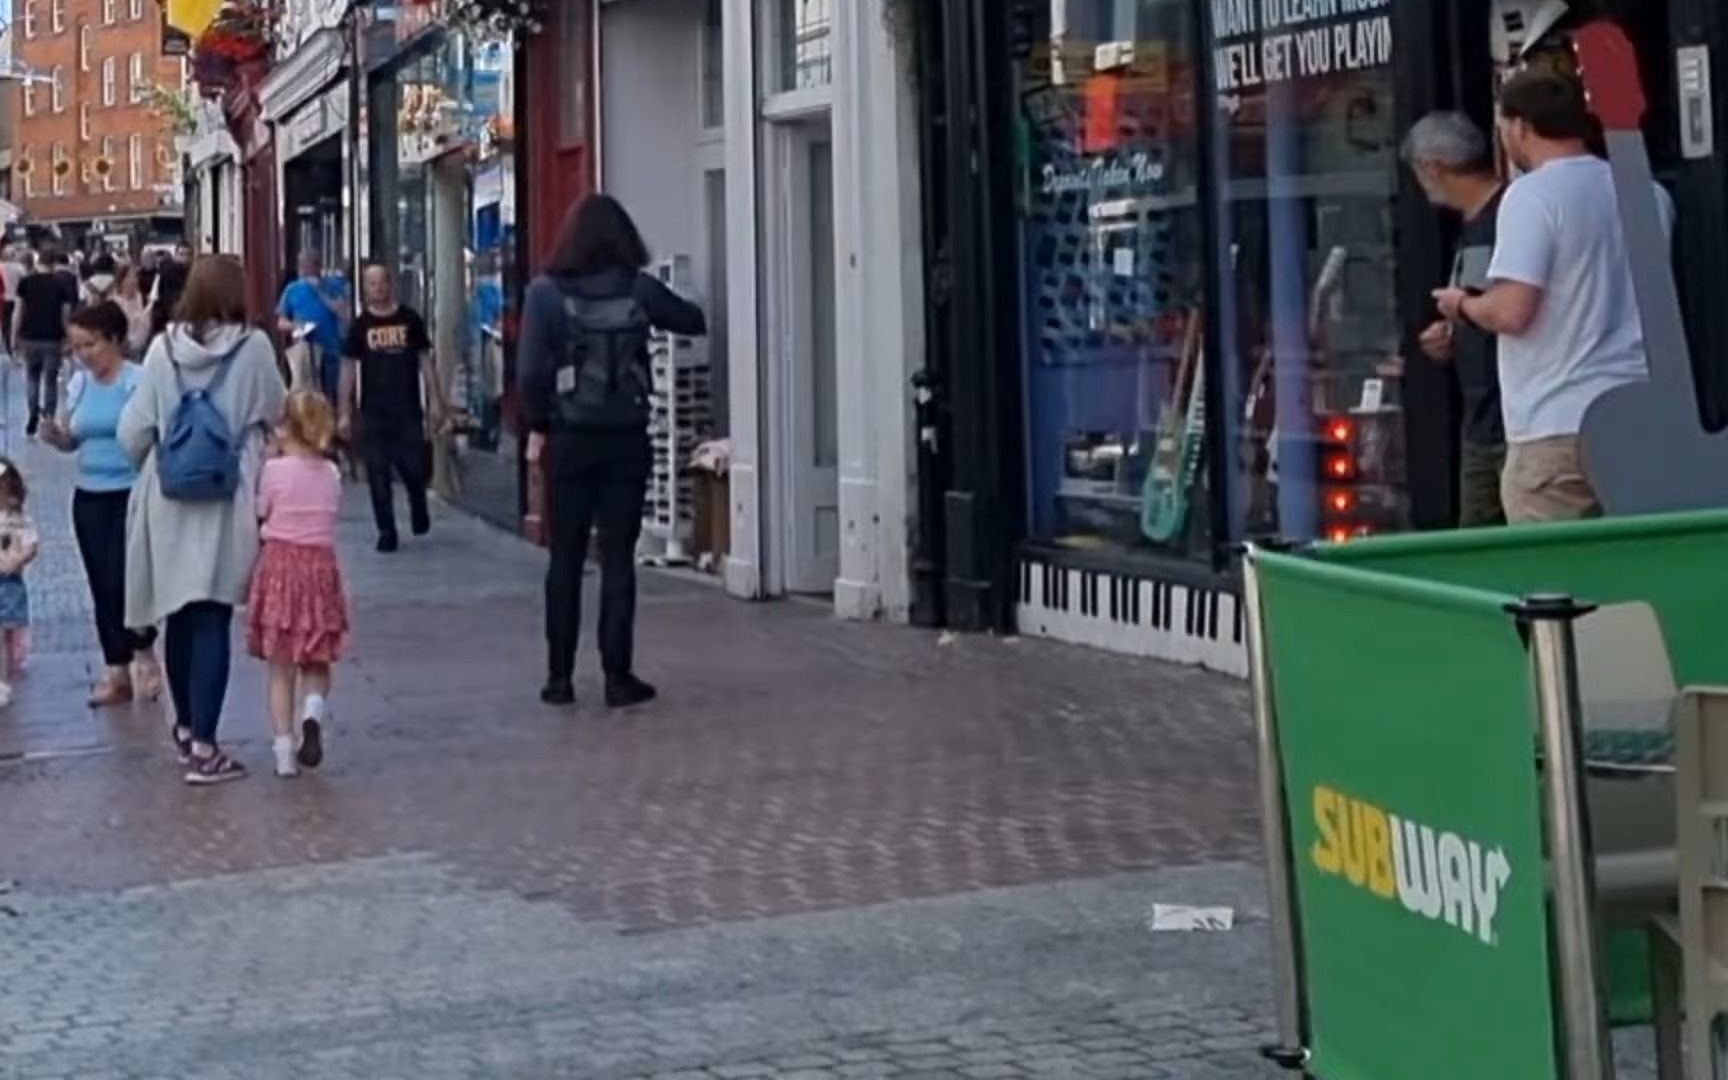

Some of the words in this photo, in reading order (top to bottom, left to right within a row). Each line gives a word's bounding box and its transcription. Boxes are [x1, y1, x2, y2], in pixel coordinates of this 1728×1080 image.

[1214, 41, 1261, 91] WE'LL
[1262, 33, 1293, 82] GET
[1295, 26, 1330, 77] YOU
[1312, 784, 1512, 944] SUBWAY
